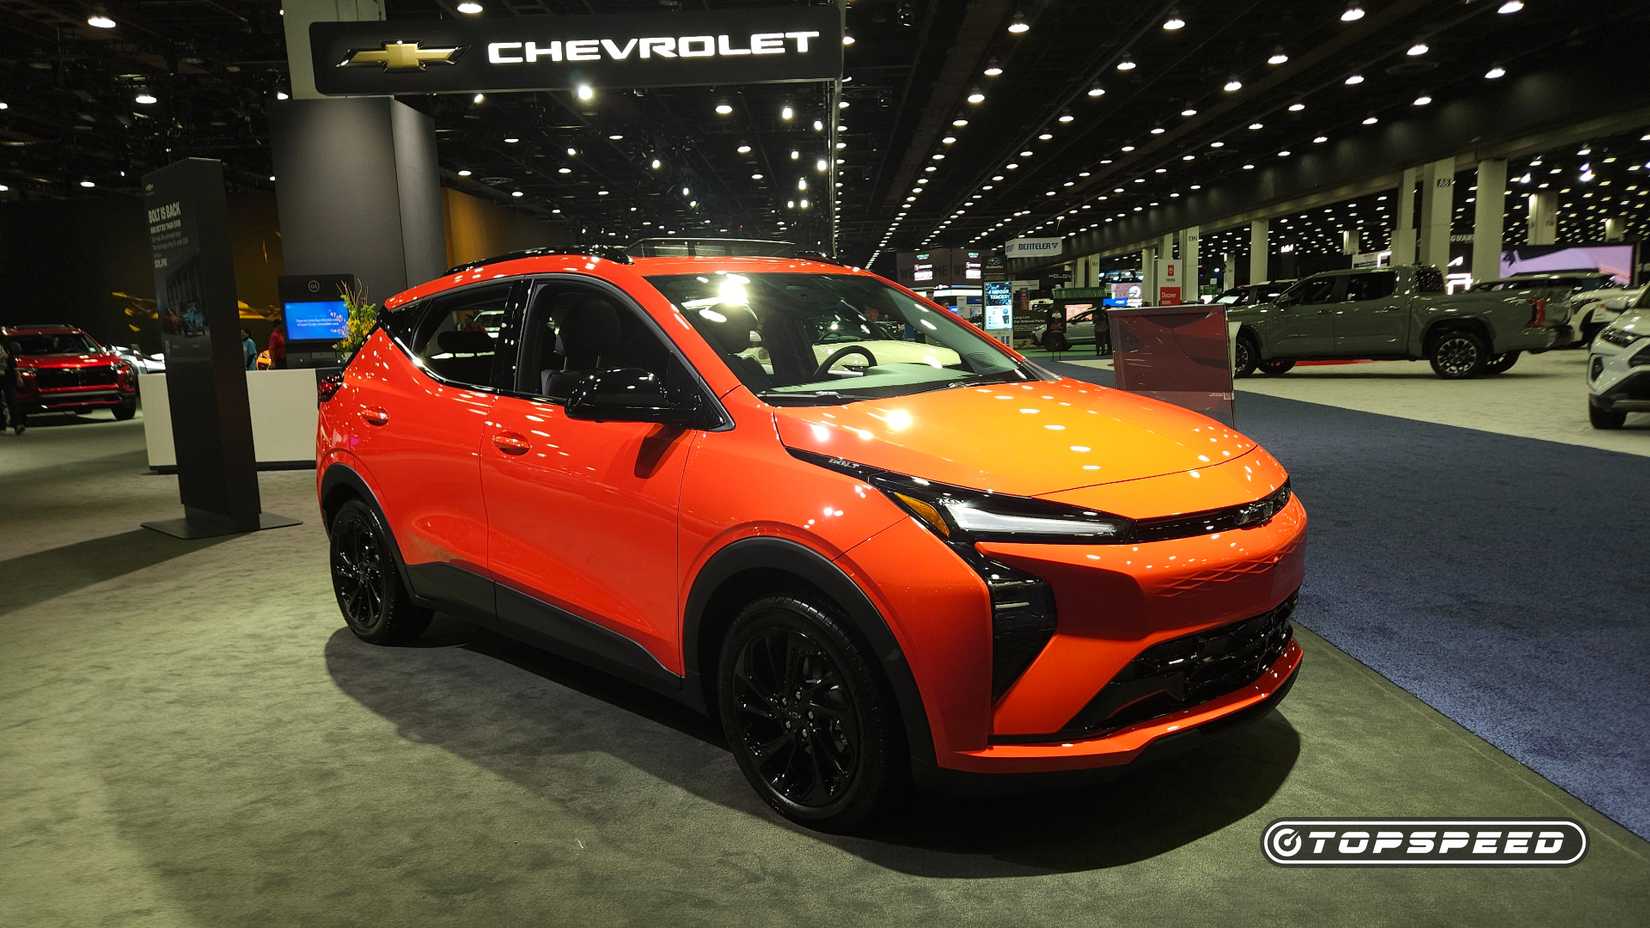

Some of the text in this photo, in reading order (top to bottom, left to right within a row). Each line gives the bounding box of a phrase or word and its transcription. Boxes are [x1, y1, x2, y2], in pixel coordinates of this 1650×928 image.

[487, 31, 820, 64] CHEVROLET
[148, 208, 160, 224] BOLT
[166, 201, 181, 218] BACK
[1018, 241, 1051, 251] BENTELER
